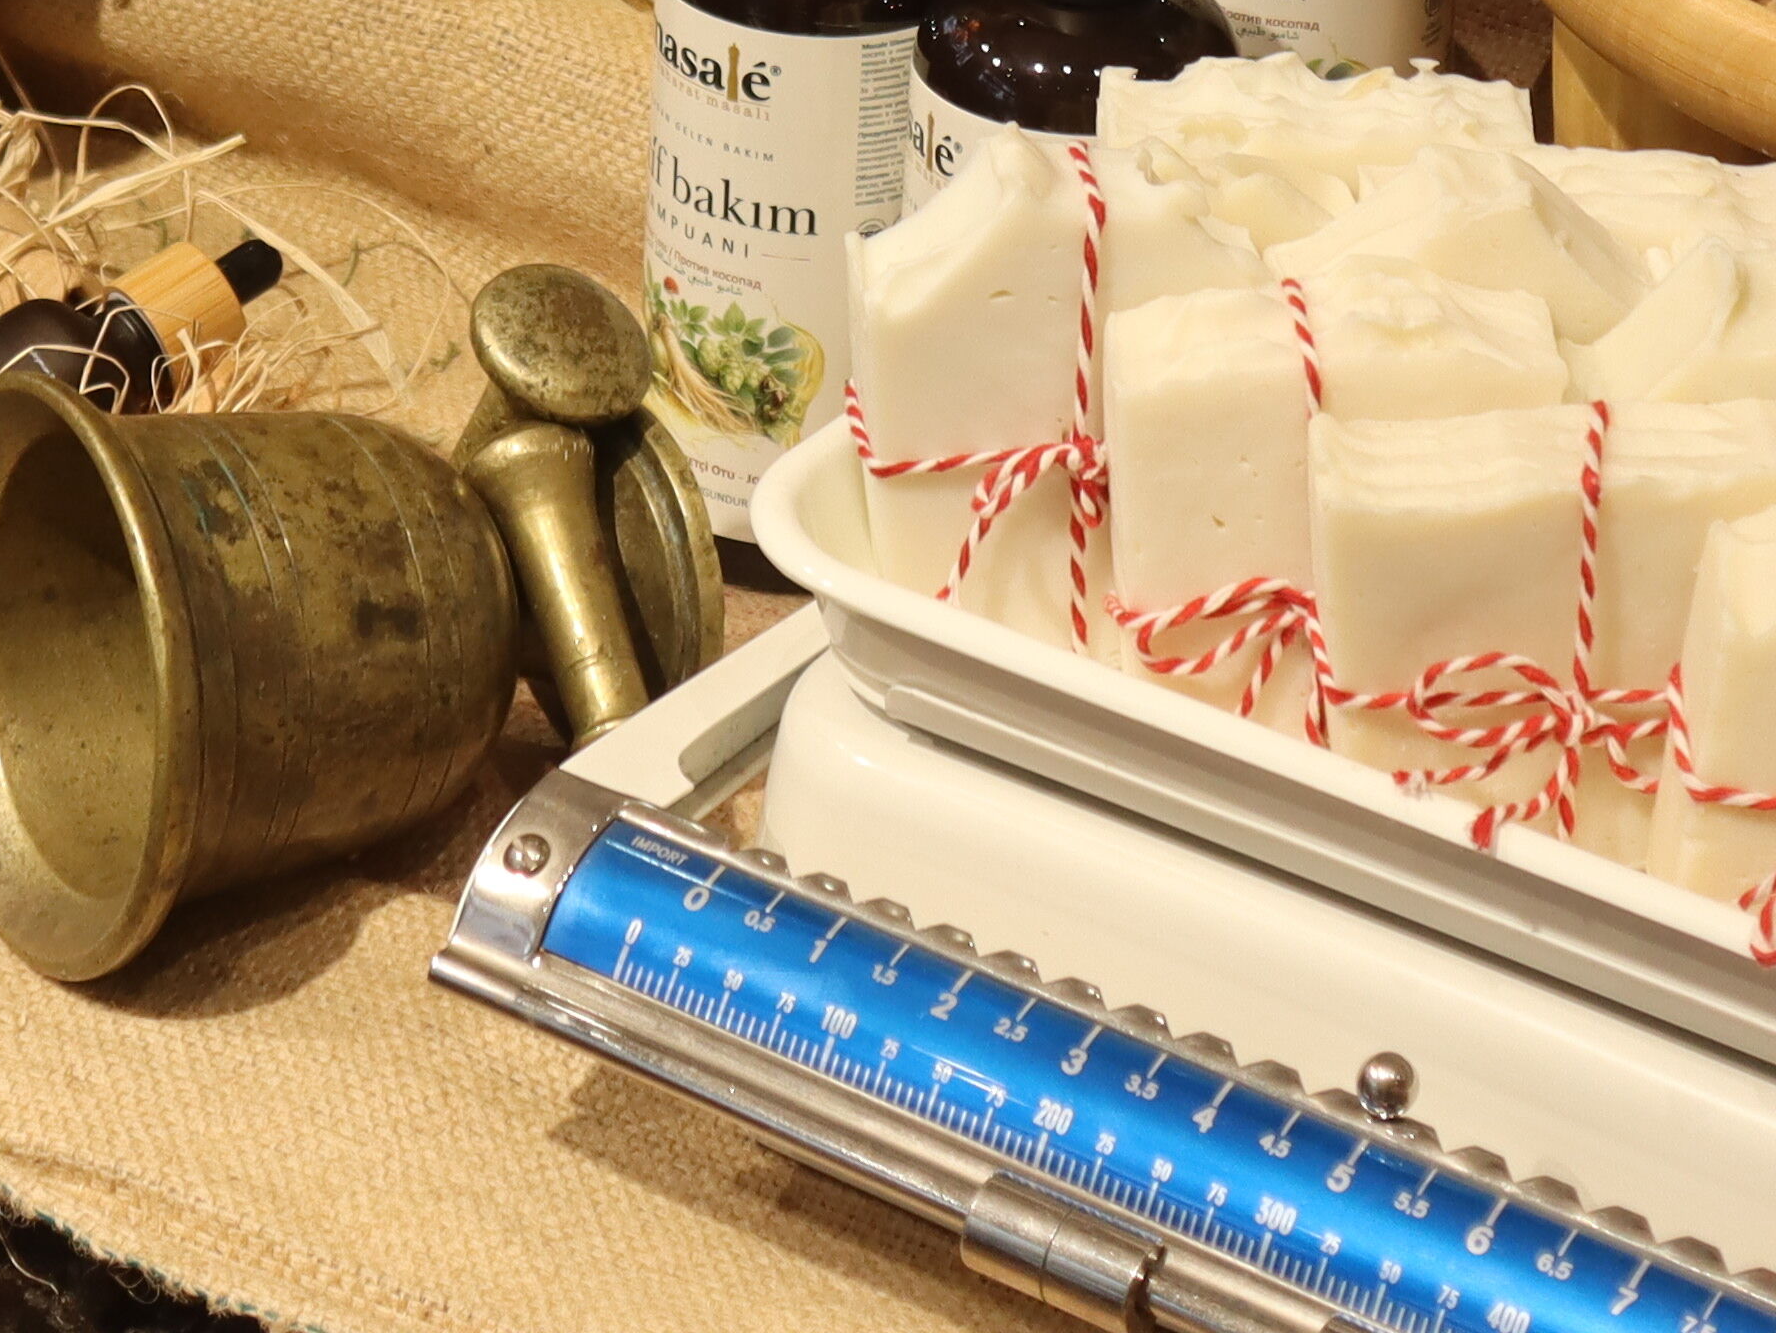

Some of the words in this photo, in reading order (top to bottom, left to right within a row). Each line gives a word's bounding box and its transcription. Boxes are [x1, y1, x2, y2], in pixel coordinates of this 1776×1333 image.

[671, 154, 819, 237] bakım
[630, 835, 690, 867] IMPORT
[624, 918, 644, 946] 0
[673, 945, 693, 968] 25
[722, 968, 744, 992] 50
[776, 990, 797, 1014] 75
[820, 1004, 859, 1040] 100
[879, 1037, 901, 1061] 25
[931, 1061, 954, 1084] 50
[1032, 1097, 1074, 1136] 200
[1094, 1132, 1117, 1156] 25
[1150, 1156, 1174, 1183] 50
[1206, 1180, 1229, 1208] 75
[1253, 1194, 1298, 1236] 300
[1378, 1259, 1403, 1285] 50
[1435, 1283, 1462, 1311] 75
[683, 885, 710, 911] 0
[743, 909, 777, 933] 0,5
[808, 939, 828, 964] 1
[929, 992, 959, 1021] 2
[992, 1016, 1029, 1043] 2,5
[1060, 1047, 1089, 1076] 3
[1124, 1073, 1160, 1101] 3,5
[1191, 1105, 1219, 1134] 4
[1325, 1162, 1356, 1193] 5
[1392, 1190, 1431, 1220] 5,5
[1466, 1225, 1494, 1256] 6
[1535, 1252, 1574, 1282] 6,5
[1610, 1286, 1640, 1317] 7
